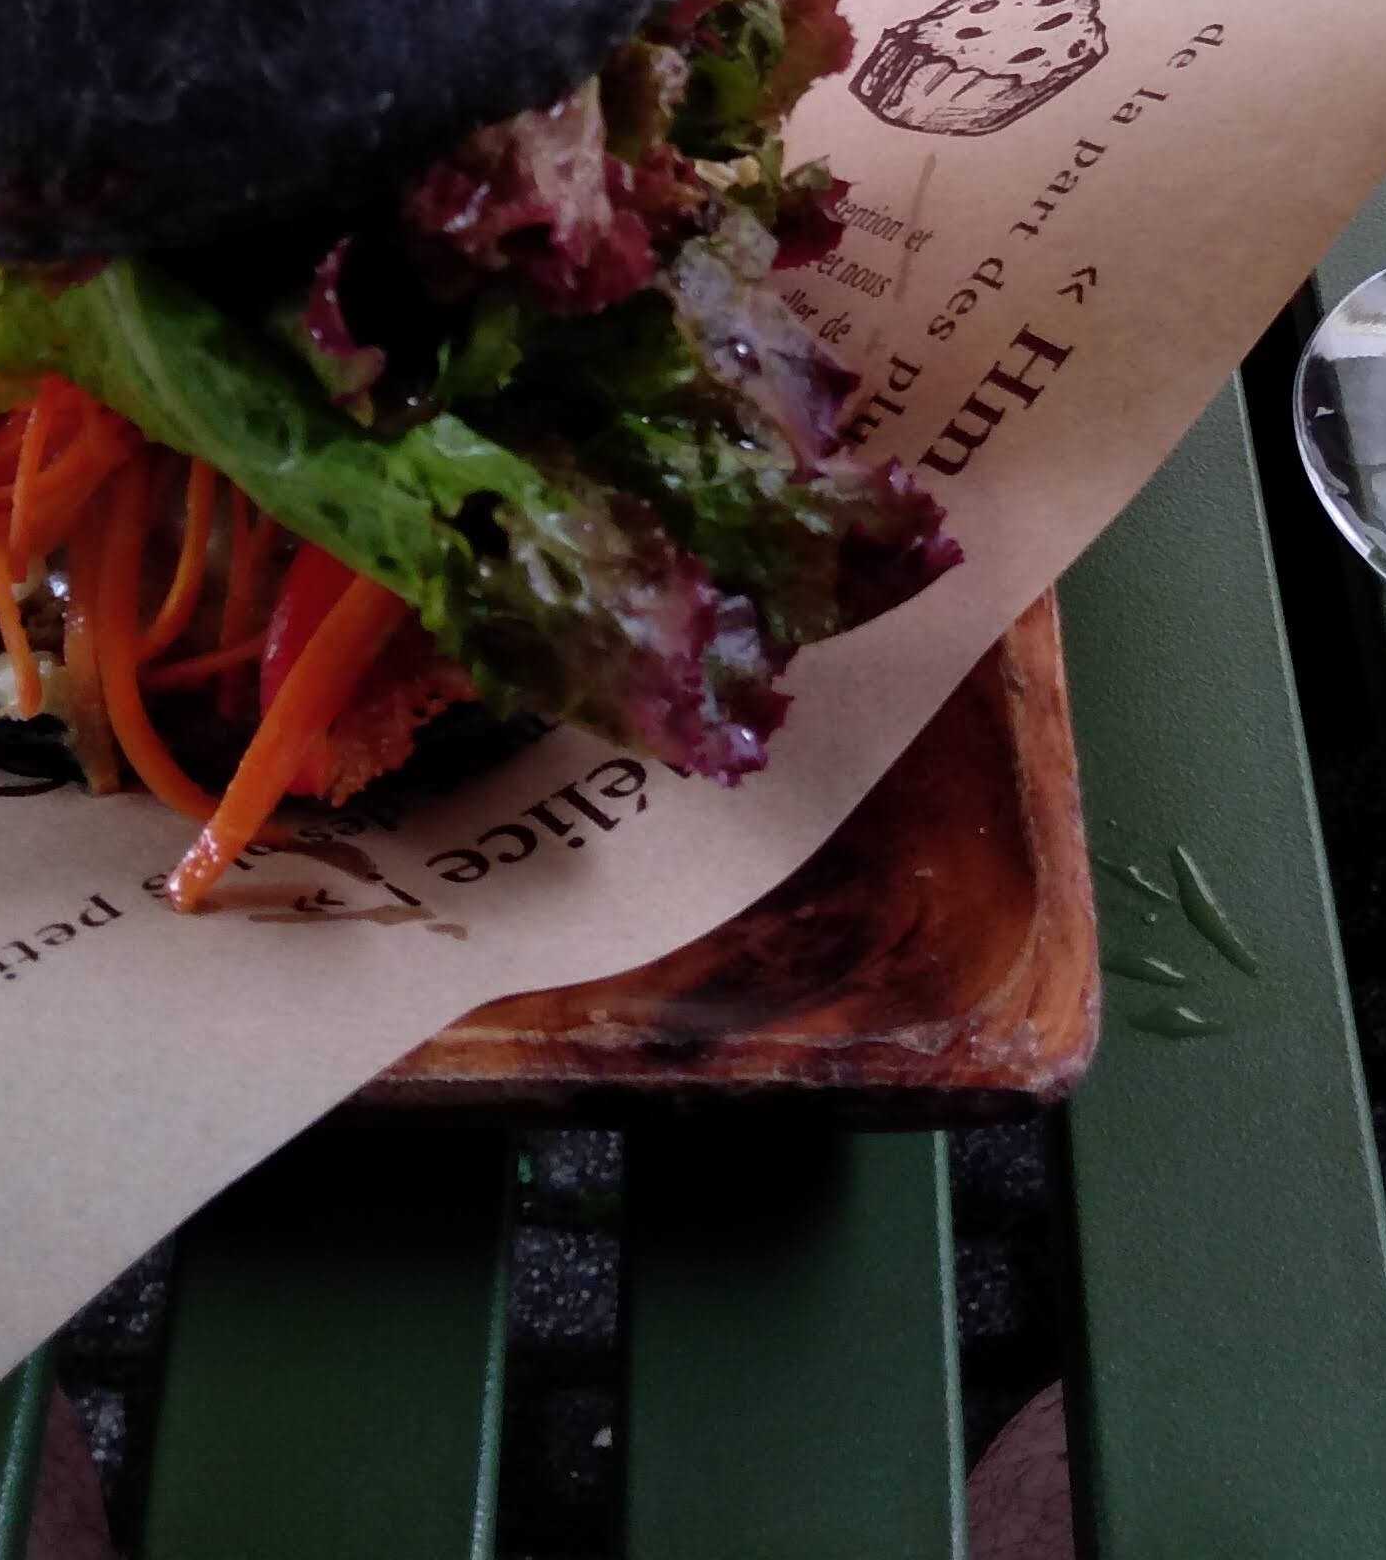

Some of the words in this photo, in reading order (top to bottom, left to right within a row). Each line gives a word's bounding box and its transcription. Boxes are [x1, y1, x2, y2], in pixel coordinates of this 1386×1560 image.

[1167, 23, 1223, 67] de
[1112, 88, 1167, 123] la
[1010, 139, 1105, 234] part
[927, 257, 1003, 340] des
[855, 355, 922, 444] plu
[917, 323, 1075, 475] Hm
